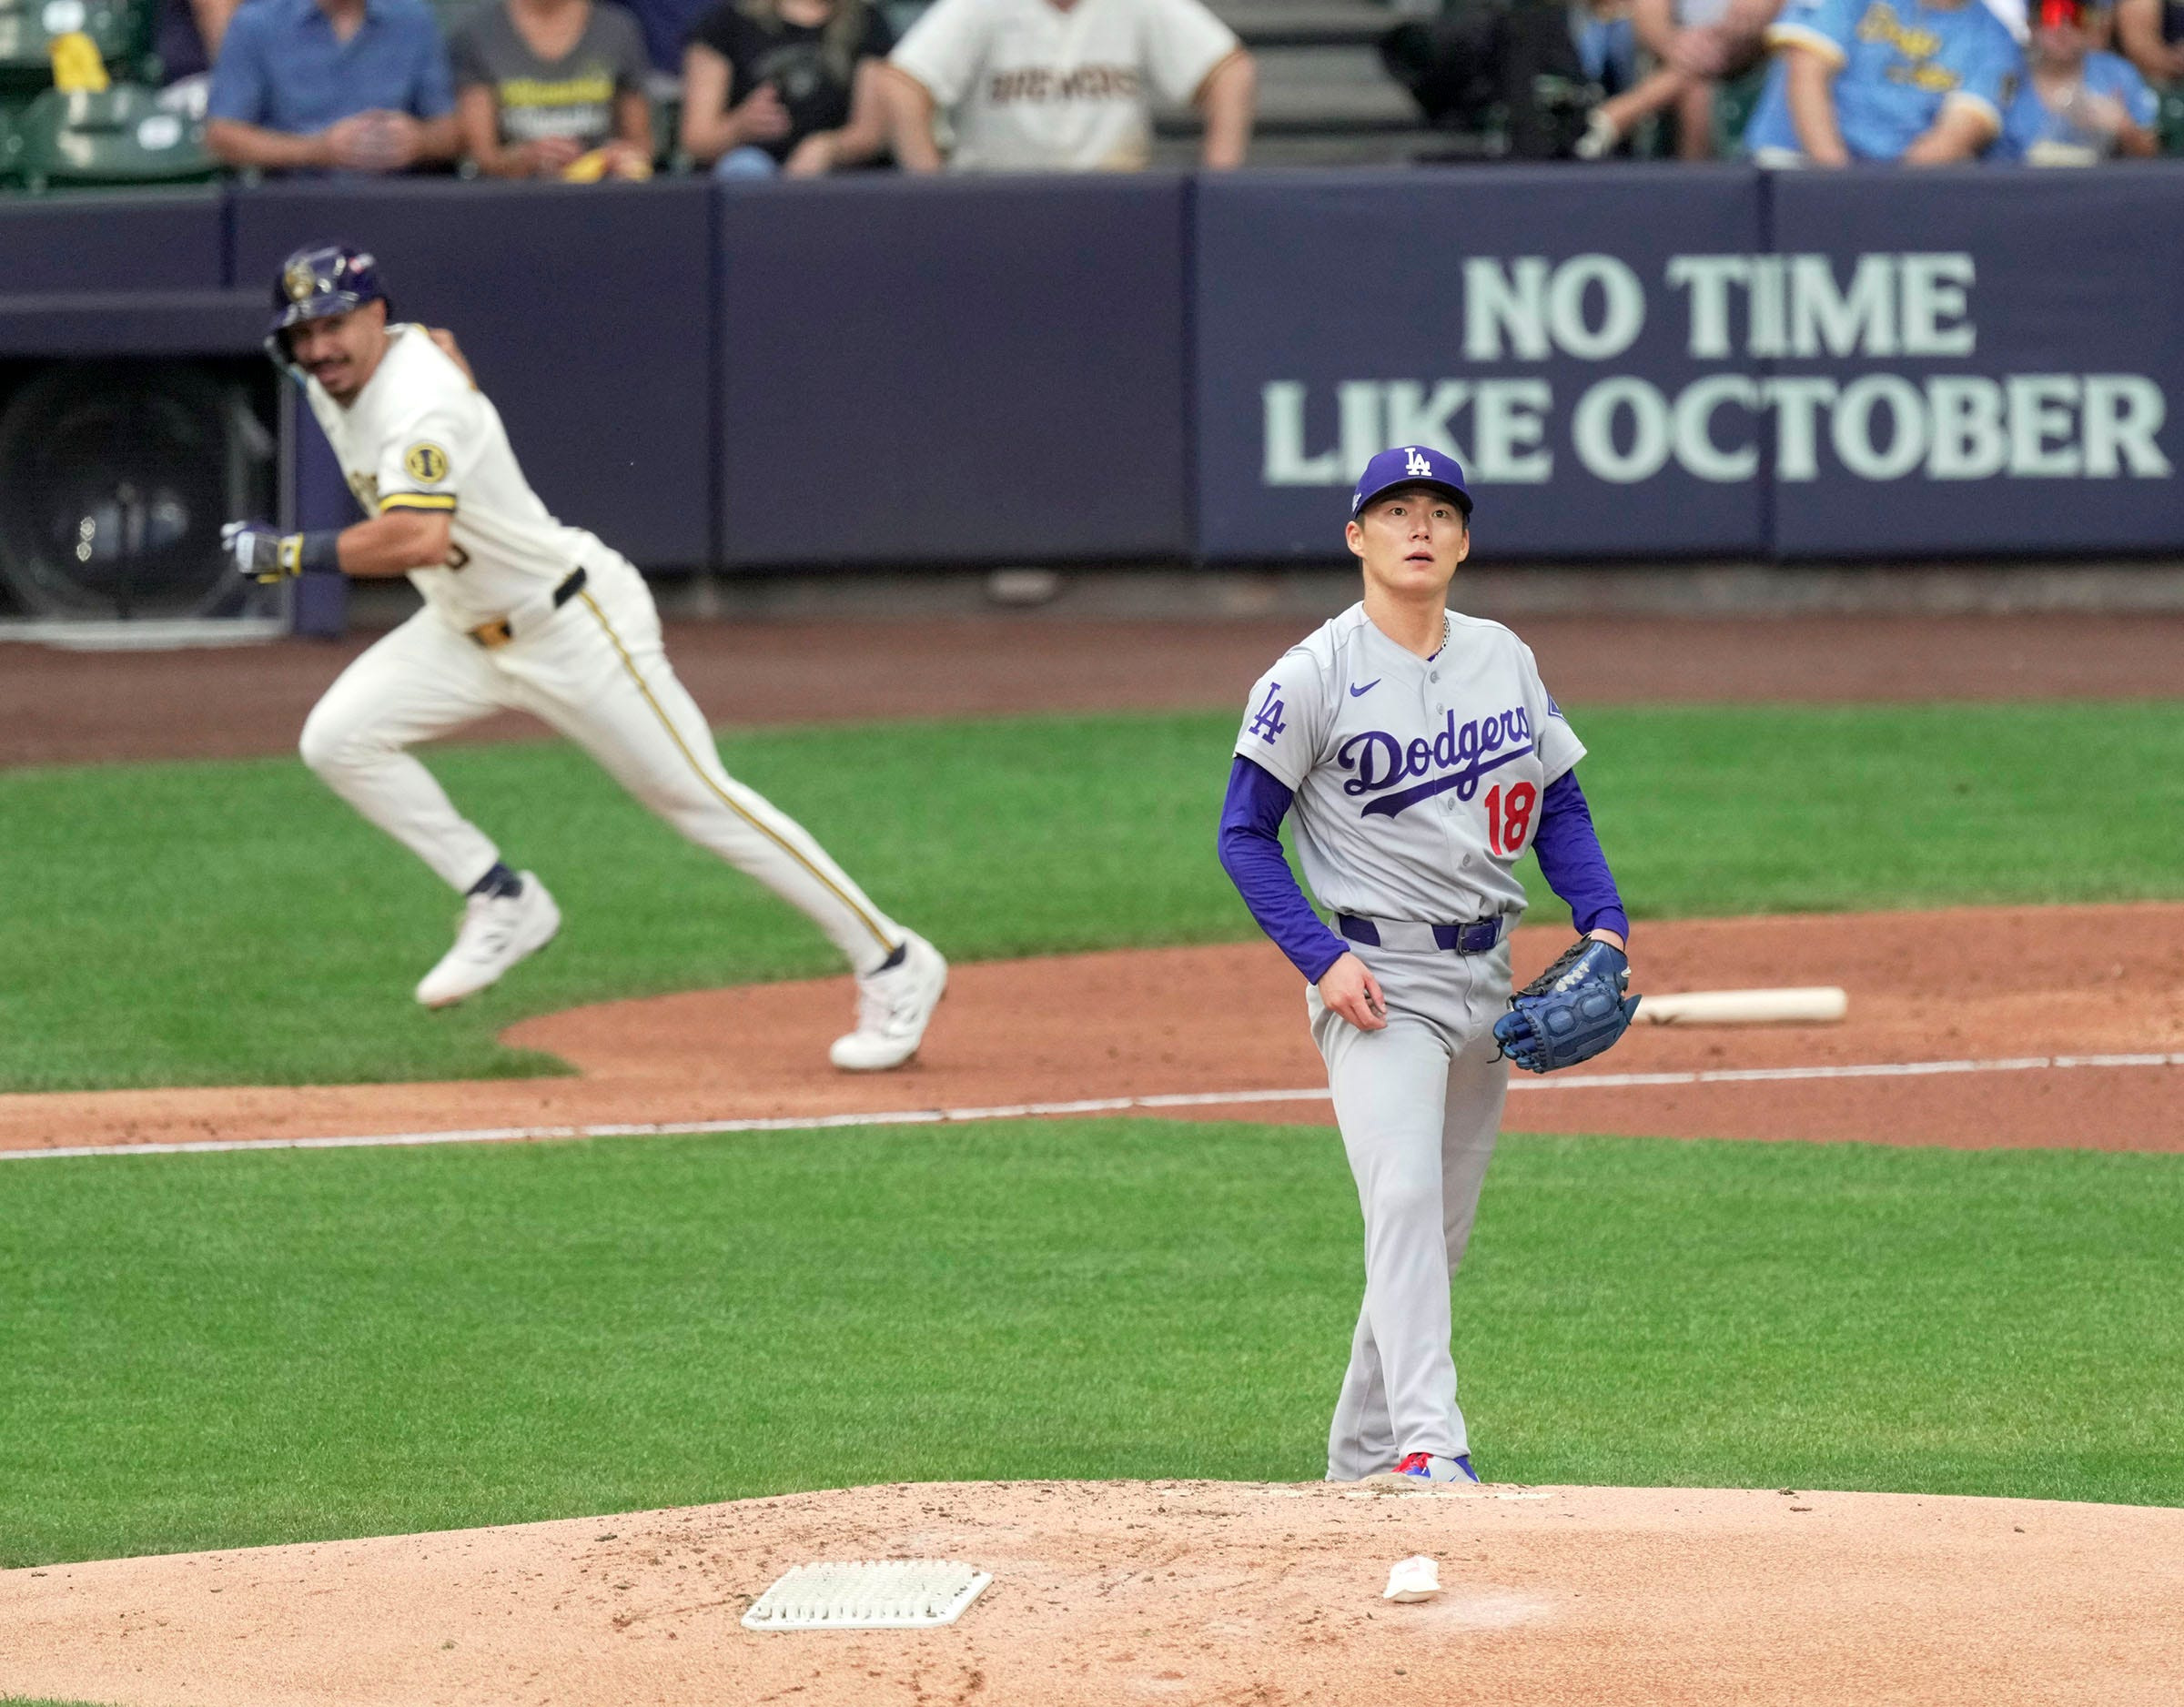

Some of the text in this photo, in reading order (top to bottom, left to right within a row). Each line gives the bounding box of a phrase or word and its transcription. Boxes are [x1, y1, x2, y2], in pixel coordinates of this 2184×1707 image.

[1463, 253, 1977, 361] NO TIME
[1262, 374, 2169, 486] LIKE OCTOBER
[1404, 447, 1432, 477] LA
[1248, 682, 1287, 746] LA
[1337, 705, 1532, 803] Dodgers
[1484, 781, 1537, 856] 18
